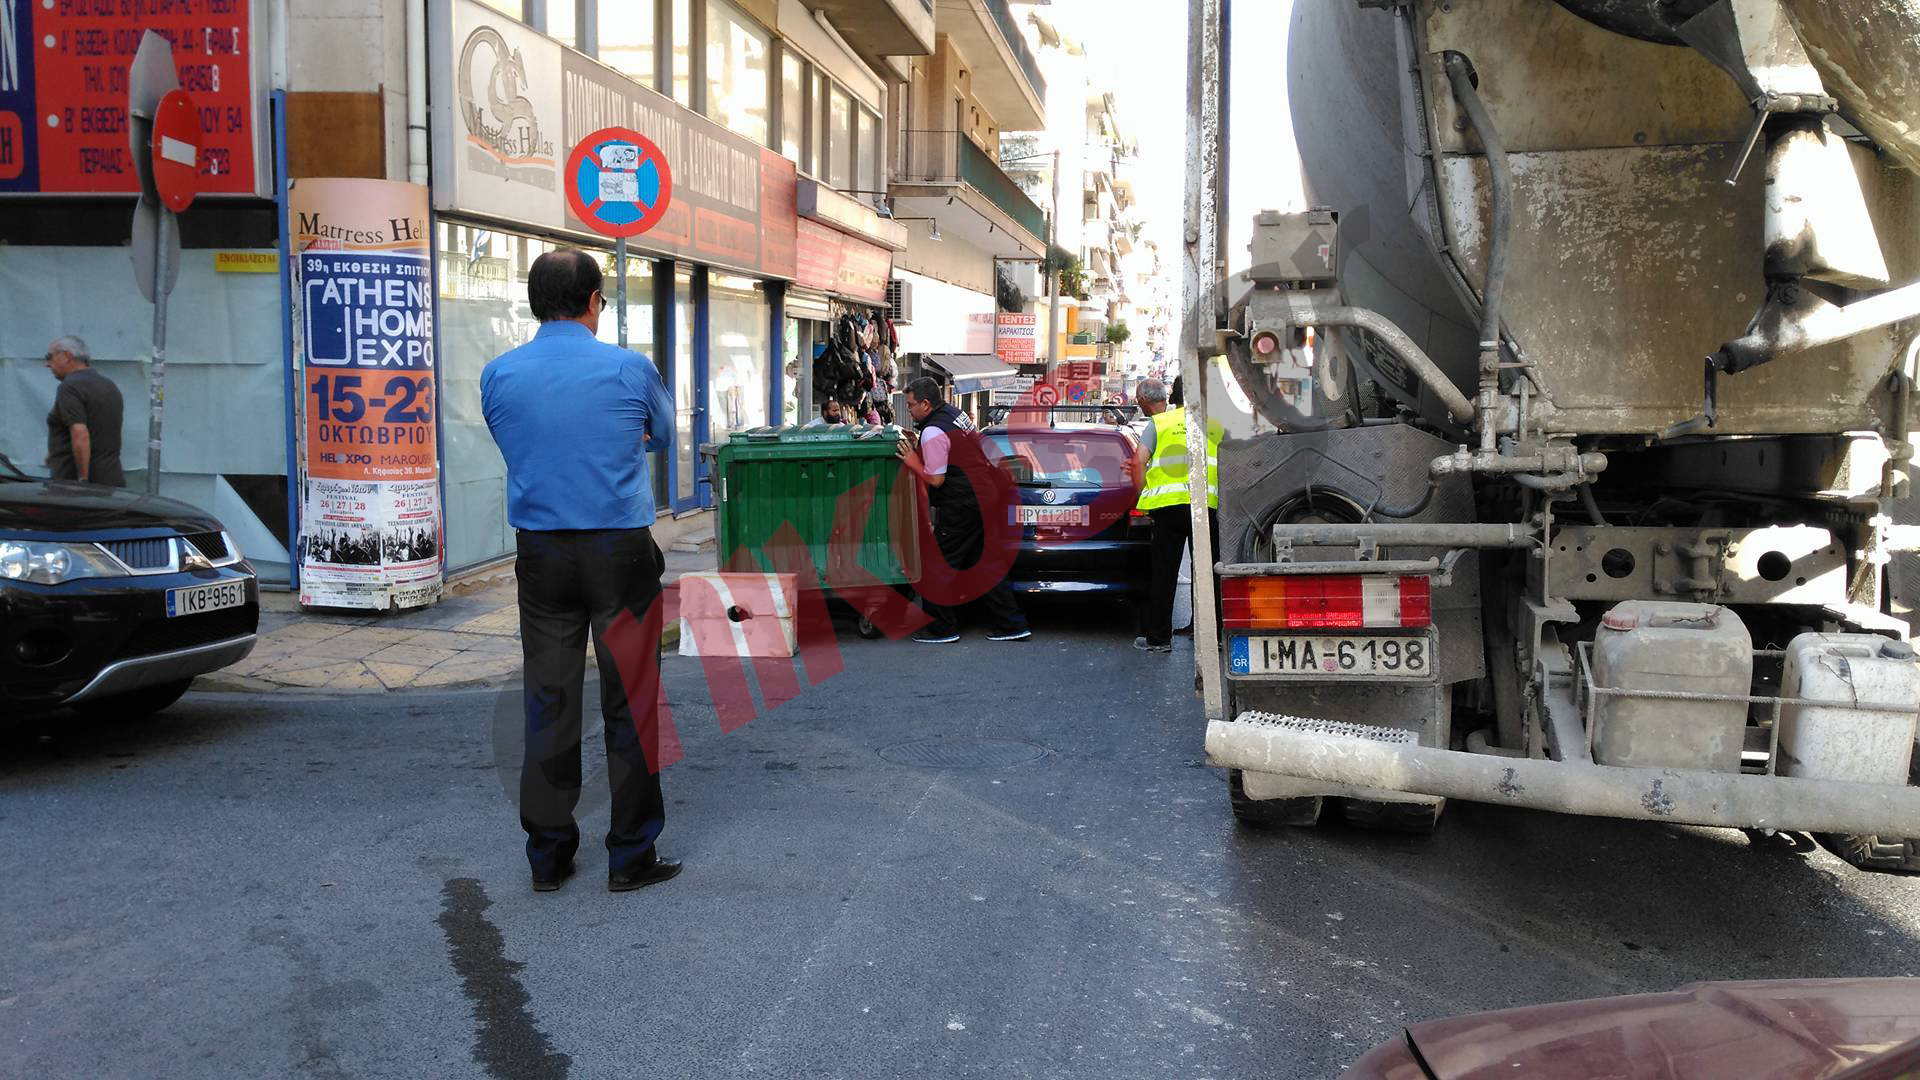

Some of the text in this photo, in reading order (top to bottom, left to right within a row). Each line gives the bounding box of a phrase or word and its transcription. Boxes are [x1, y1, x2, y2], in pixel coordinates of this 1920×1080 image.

[299, 212, 384, 244] Mattress
[307, 259, 329, 274] 39η
[333, 262, 391, 275] ΕΚΘΕΣΗ
[322, 278, 431, 309] ATHENS
[356, 308, 432, 338] HOME
[999, 315, 1034, 324] ΤΕΝΤΕΣ
[999, 328, 1034, 336] ΚΑΡΑΚΙΤΣΟΣ
[356, 339, 433, 367] EXPO
[311, 374, 433, 424] 15-23
[319, 424, 432, 445] ΟΚΤΩΒΡΙΟΥ
[182, 583, 243, 612] IKB-9561
[1233, 640, 1424, 670] GR IMA-6198
